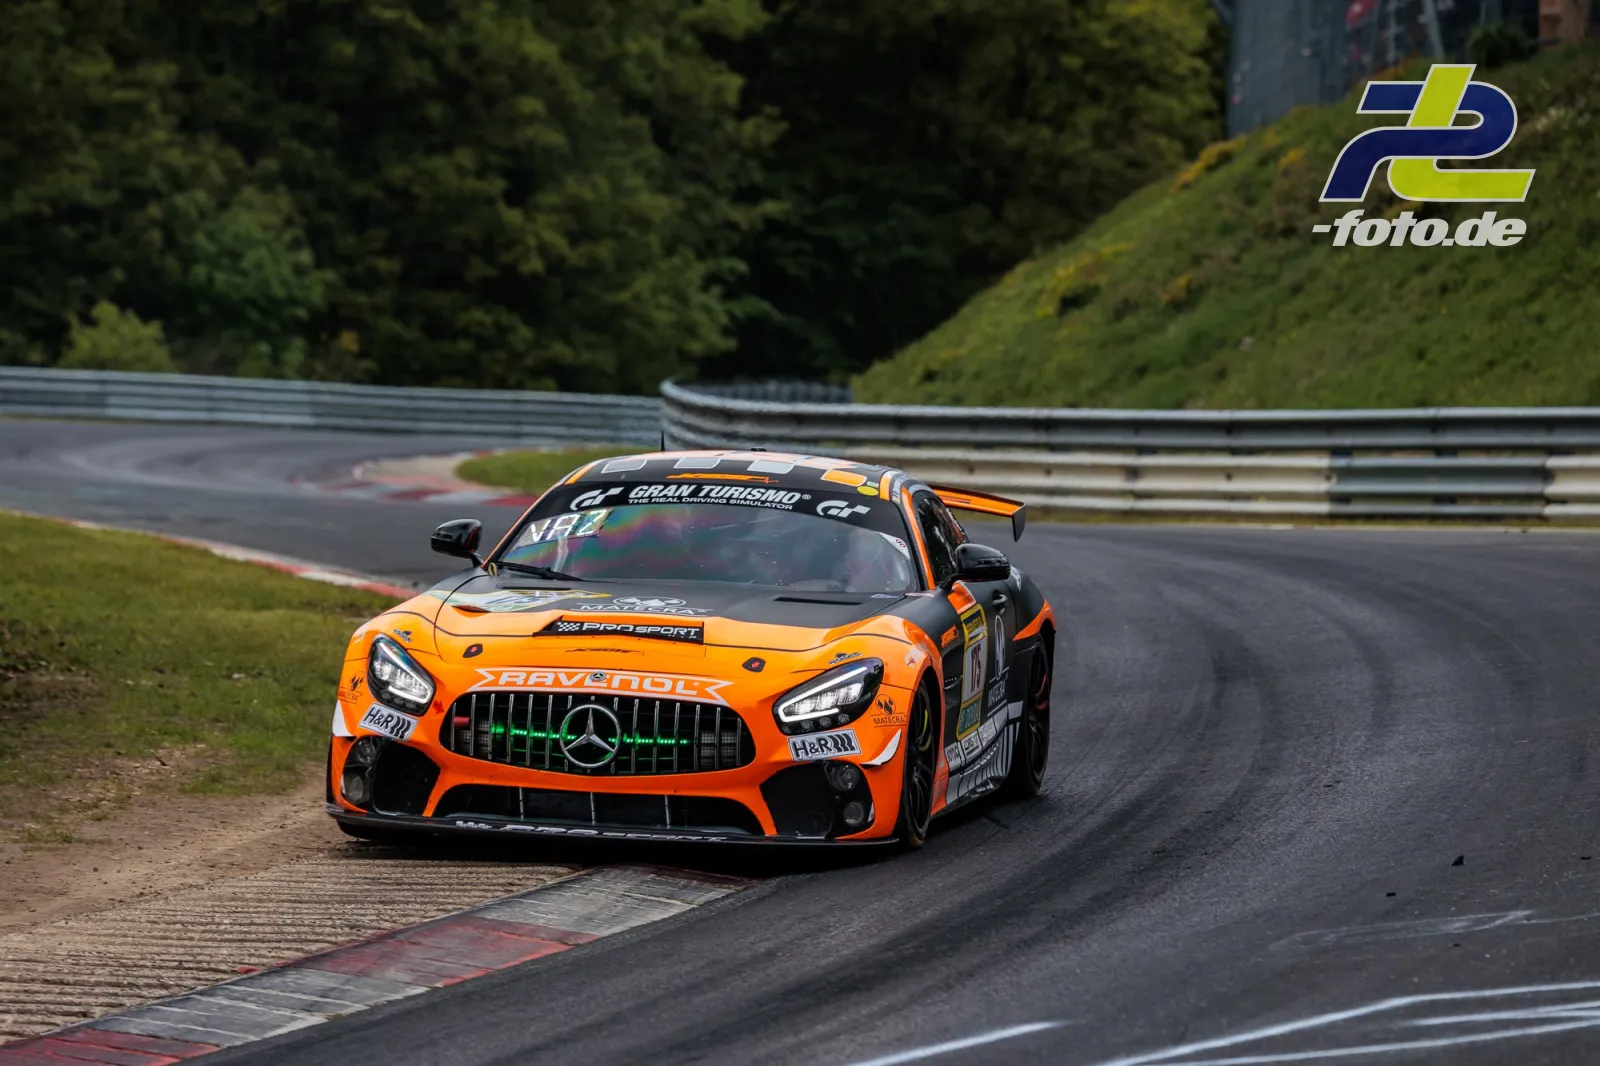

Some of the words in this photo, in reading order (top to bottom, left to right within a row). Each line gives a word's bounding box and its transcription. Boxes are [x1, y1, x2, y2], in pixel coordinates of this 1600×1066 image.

[628, 484, 697, 499] GRAN
[729, 499, 793, 511] SIMULATOR
[498, 671, 699, 696] RAVENOL
[363, 706, 395, 730] H&R
[873, 715, 905, 725] MATECRA
[792, 737, 833, 758] H&R
